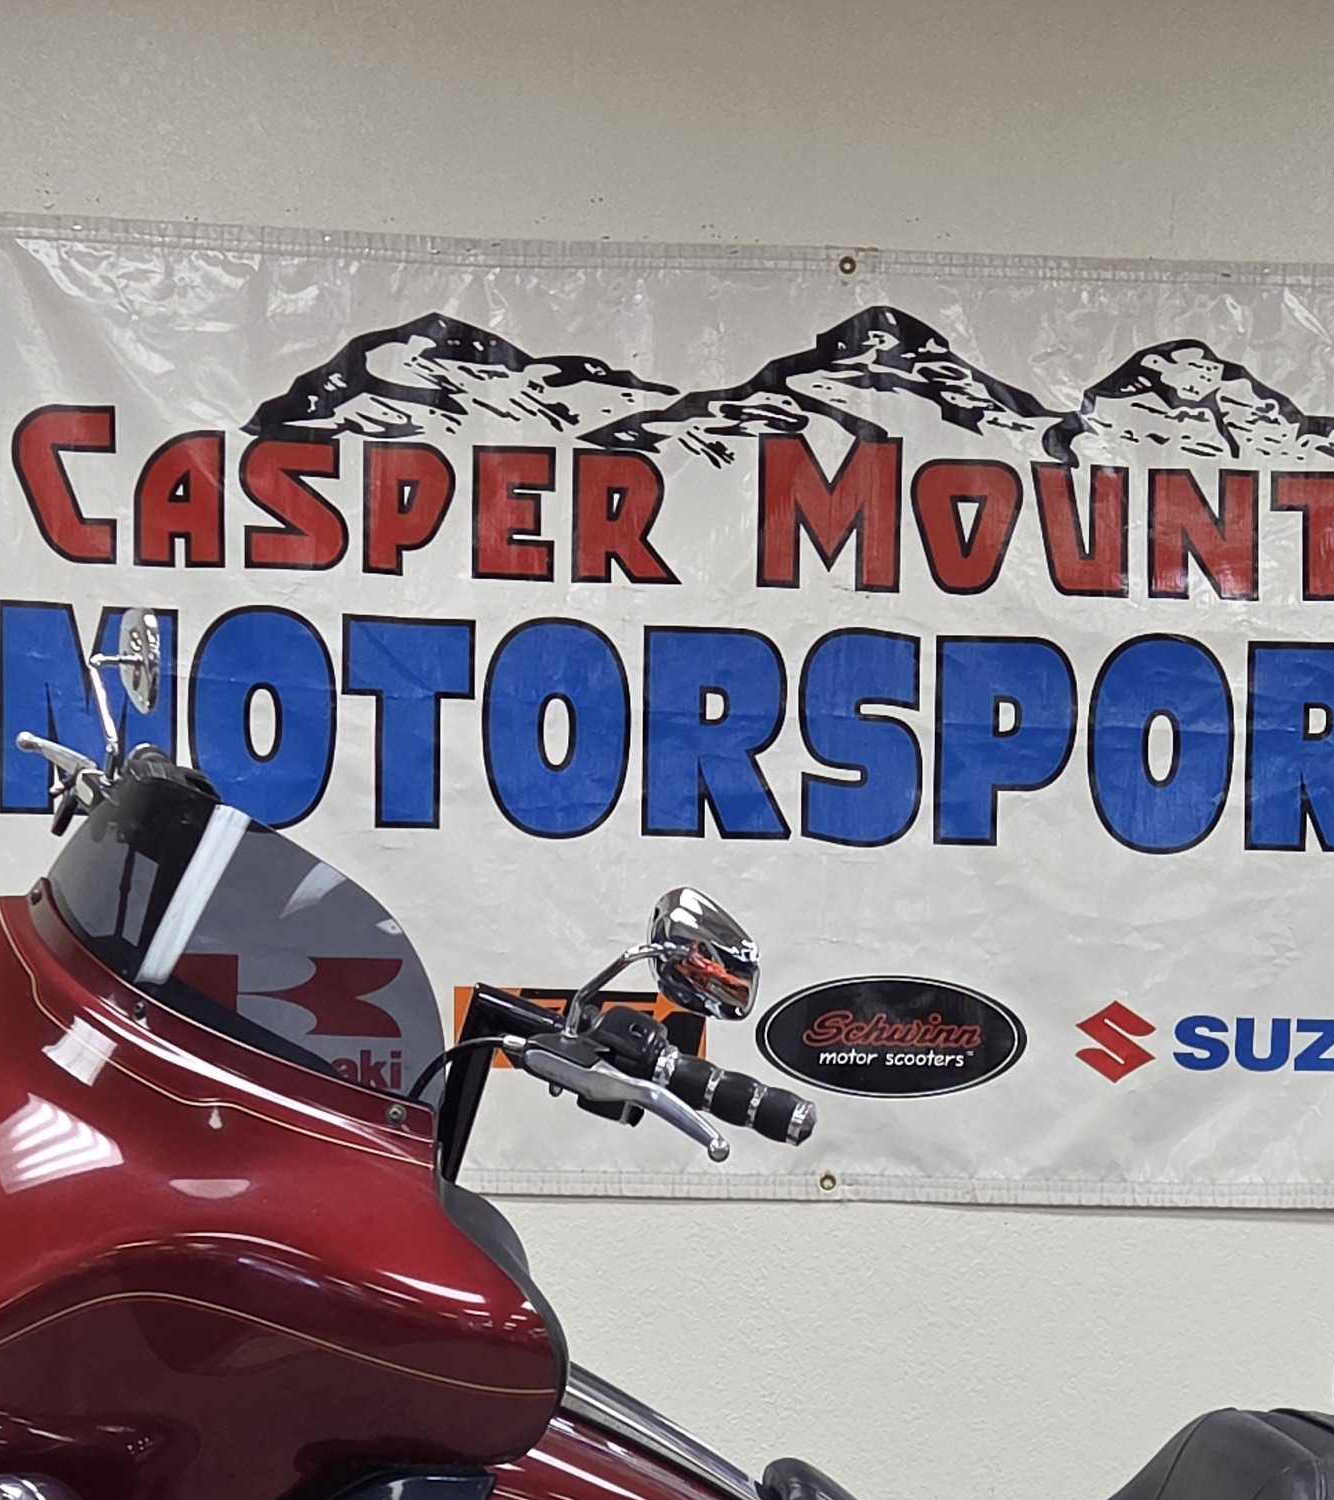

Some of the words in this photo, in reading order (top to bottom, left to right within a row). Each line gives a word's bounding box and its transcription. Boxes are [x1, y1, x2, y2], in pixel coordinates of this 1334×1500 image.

[12, 404, 681, 585] CASPER
[803, 1010, 982, 1049] Schwinn
[818, 1049, 878, 1066] motor
